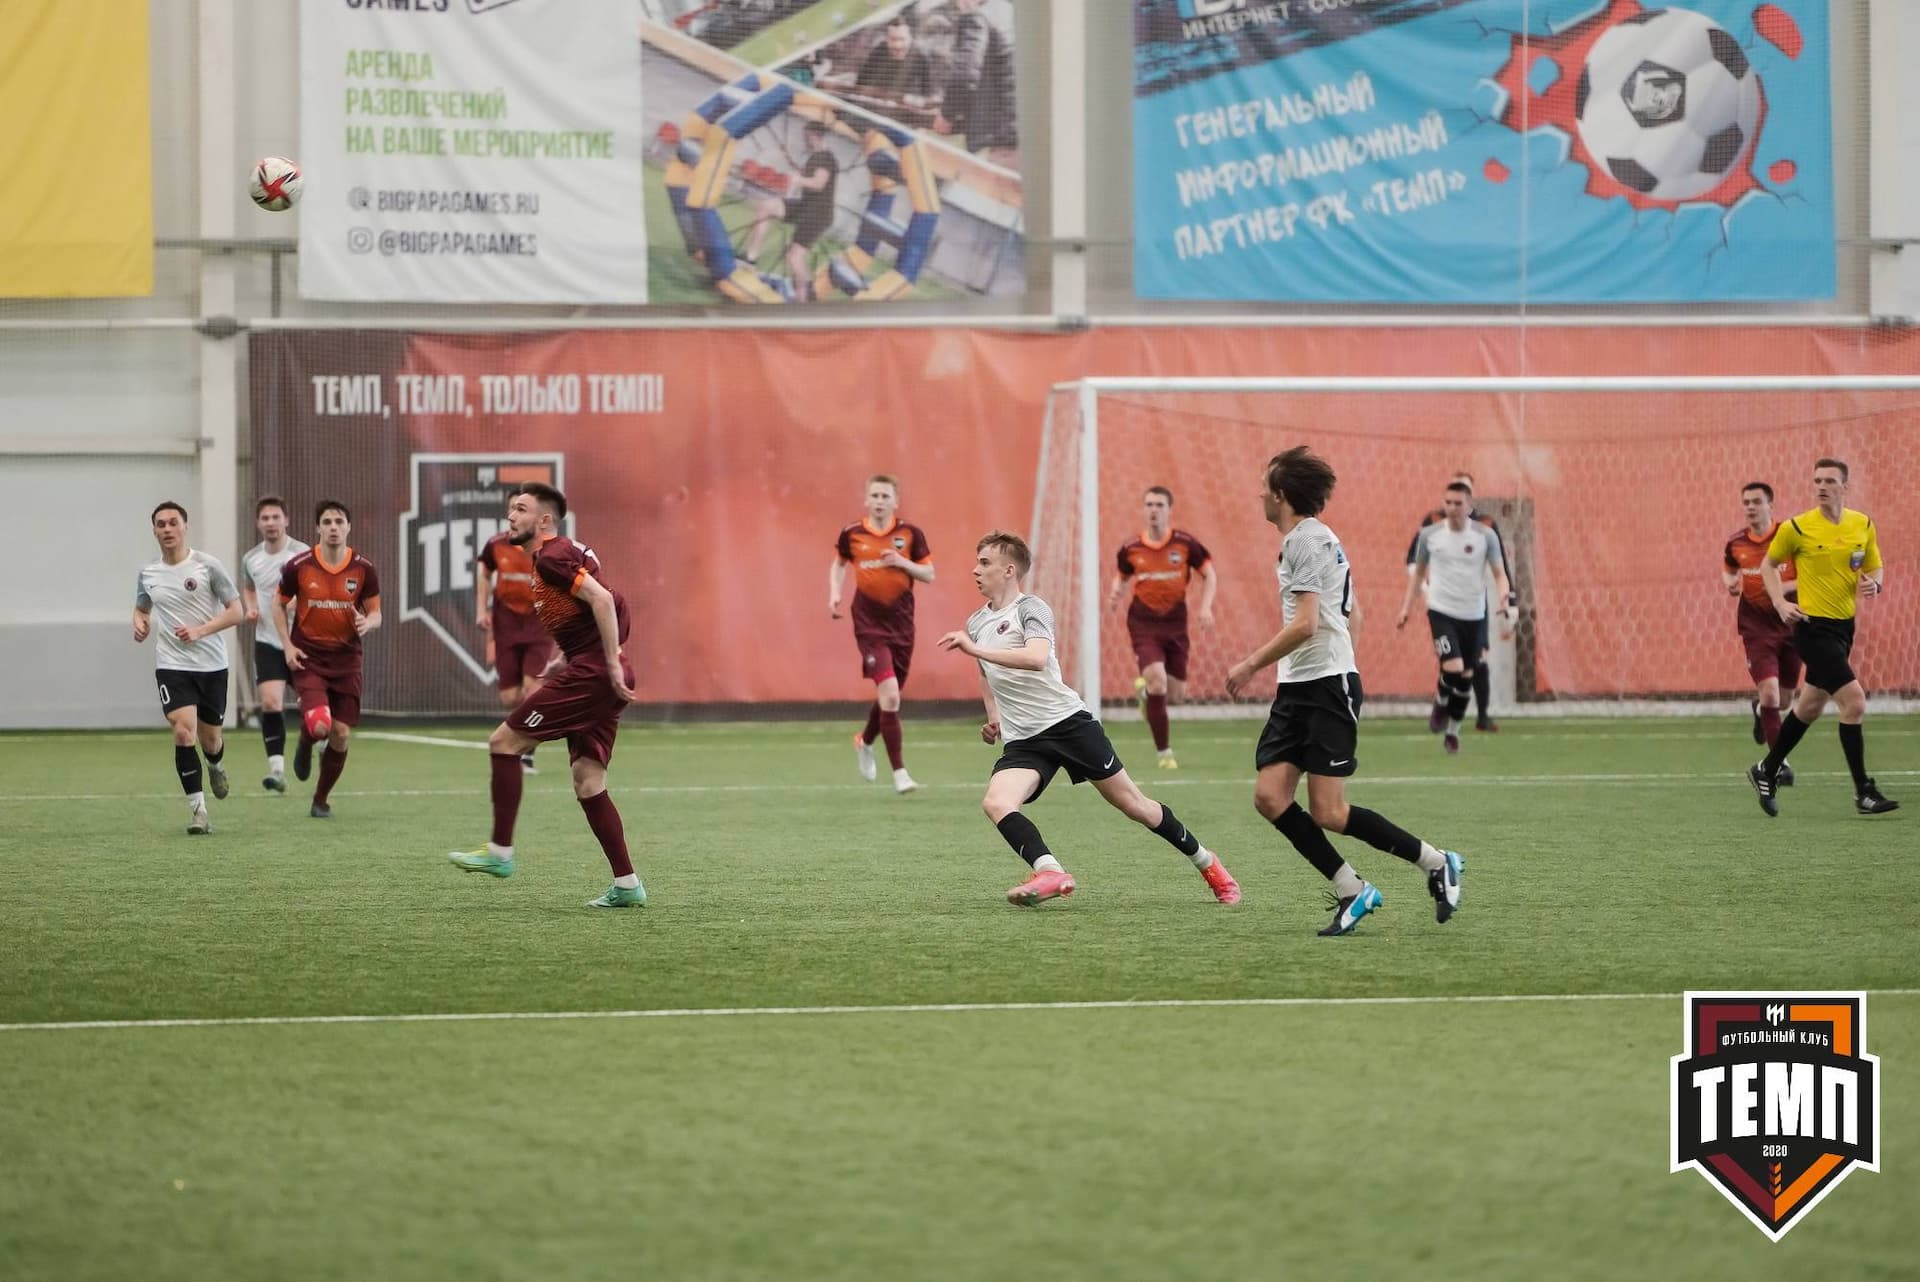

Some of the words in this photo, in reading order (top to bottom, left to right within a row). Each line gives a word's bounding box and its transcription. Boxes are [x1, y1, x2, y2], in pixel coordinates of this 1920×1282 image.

[1182, 3, 1289, 40] ИНТЕРНЕТ
[345, 50, 433, 81] АРЕНДА
[346, 87, 507, 119] РАЗВЛЕЧЕНИЙ
[1174, 71, 1376, 148] ГЕНЕРАЛЬНЫЙ
[346, 126, 376, 154] НА
[383, 127, 447, 156] ВАШЕ
[453, 129, 615, 159] МЕРОПРИЯТИЕ
[1175, 110, 1449, 207] ИНФОРМАЦИОННЫЙ
[377, 190, 540, 215] BIGPAPAGAMES.RU
[1174, 203, 1300, 260] ПАРТНЕР
[1306, 190, 1355, 231] ФК
[1361, 168, 1467, 216] «ТЕМП»
[378, 230, 538, 257] @BIGPAPAGAMES
[312, 375, 390, 419] ТЕМП,
[396, 375, 473, 418] ТЕМП,
[480, 374, 581, 415] ТОЛЬКО
[587, 374, 665, 414] ТЕМП!
[524, 710, 545, 729] 10
